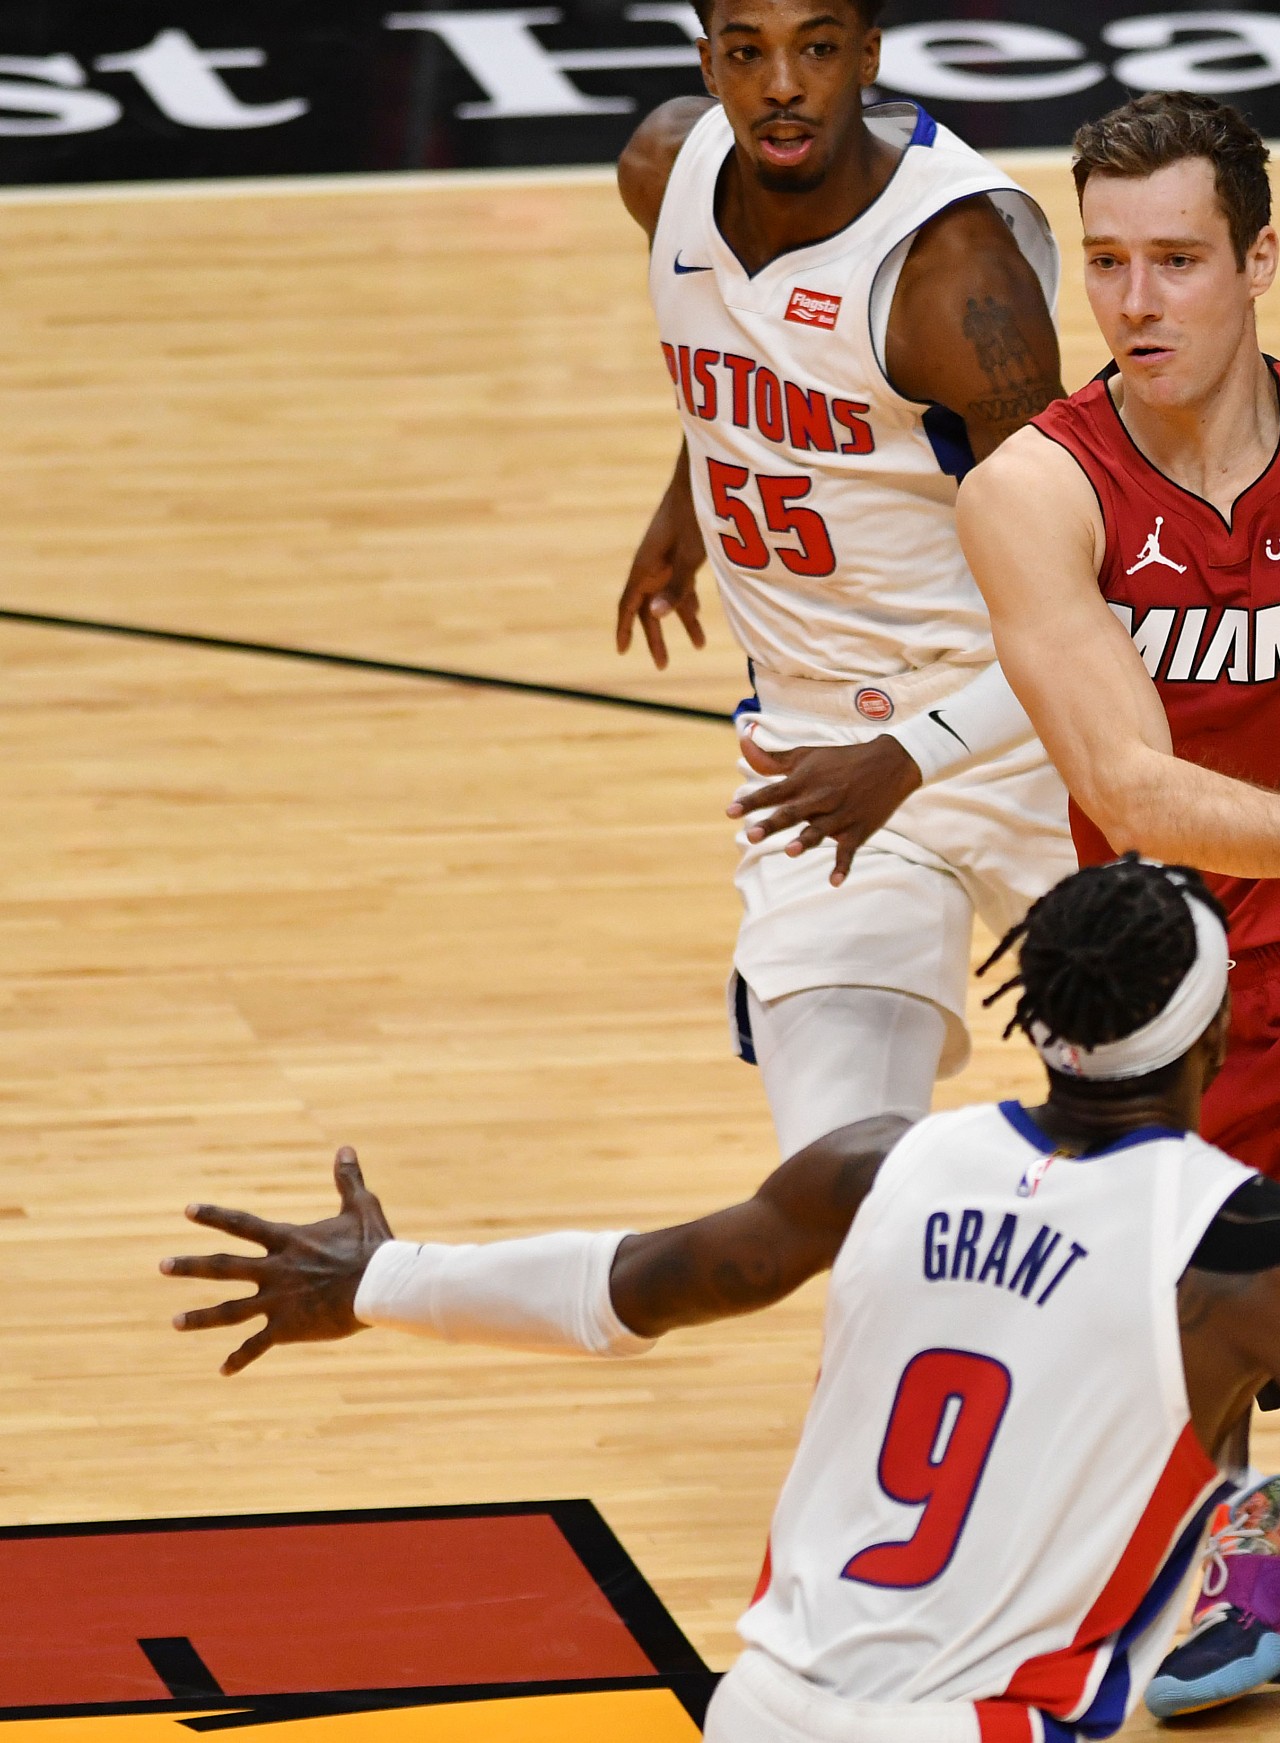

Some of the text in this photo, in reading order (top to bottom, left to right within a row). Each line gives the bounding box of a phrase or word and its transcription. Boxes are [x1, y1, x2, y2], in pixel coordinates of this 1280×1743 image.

[0, 27, 310, 136] st
[706, 456, 836, 577] 55
[924, 1209, 1089, 1309] GRANT
[838, 1347, 1013, 1590] 9
